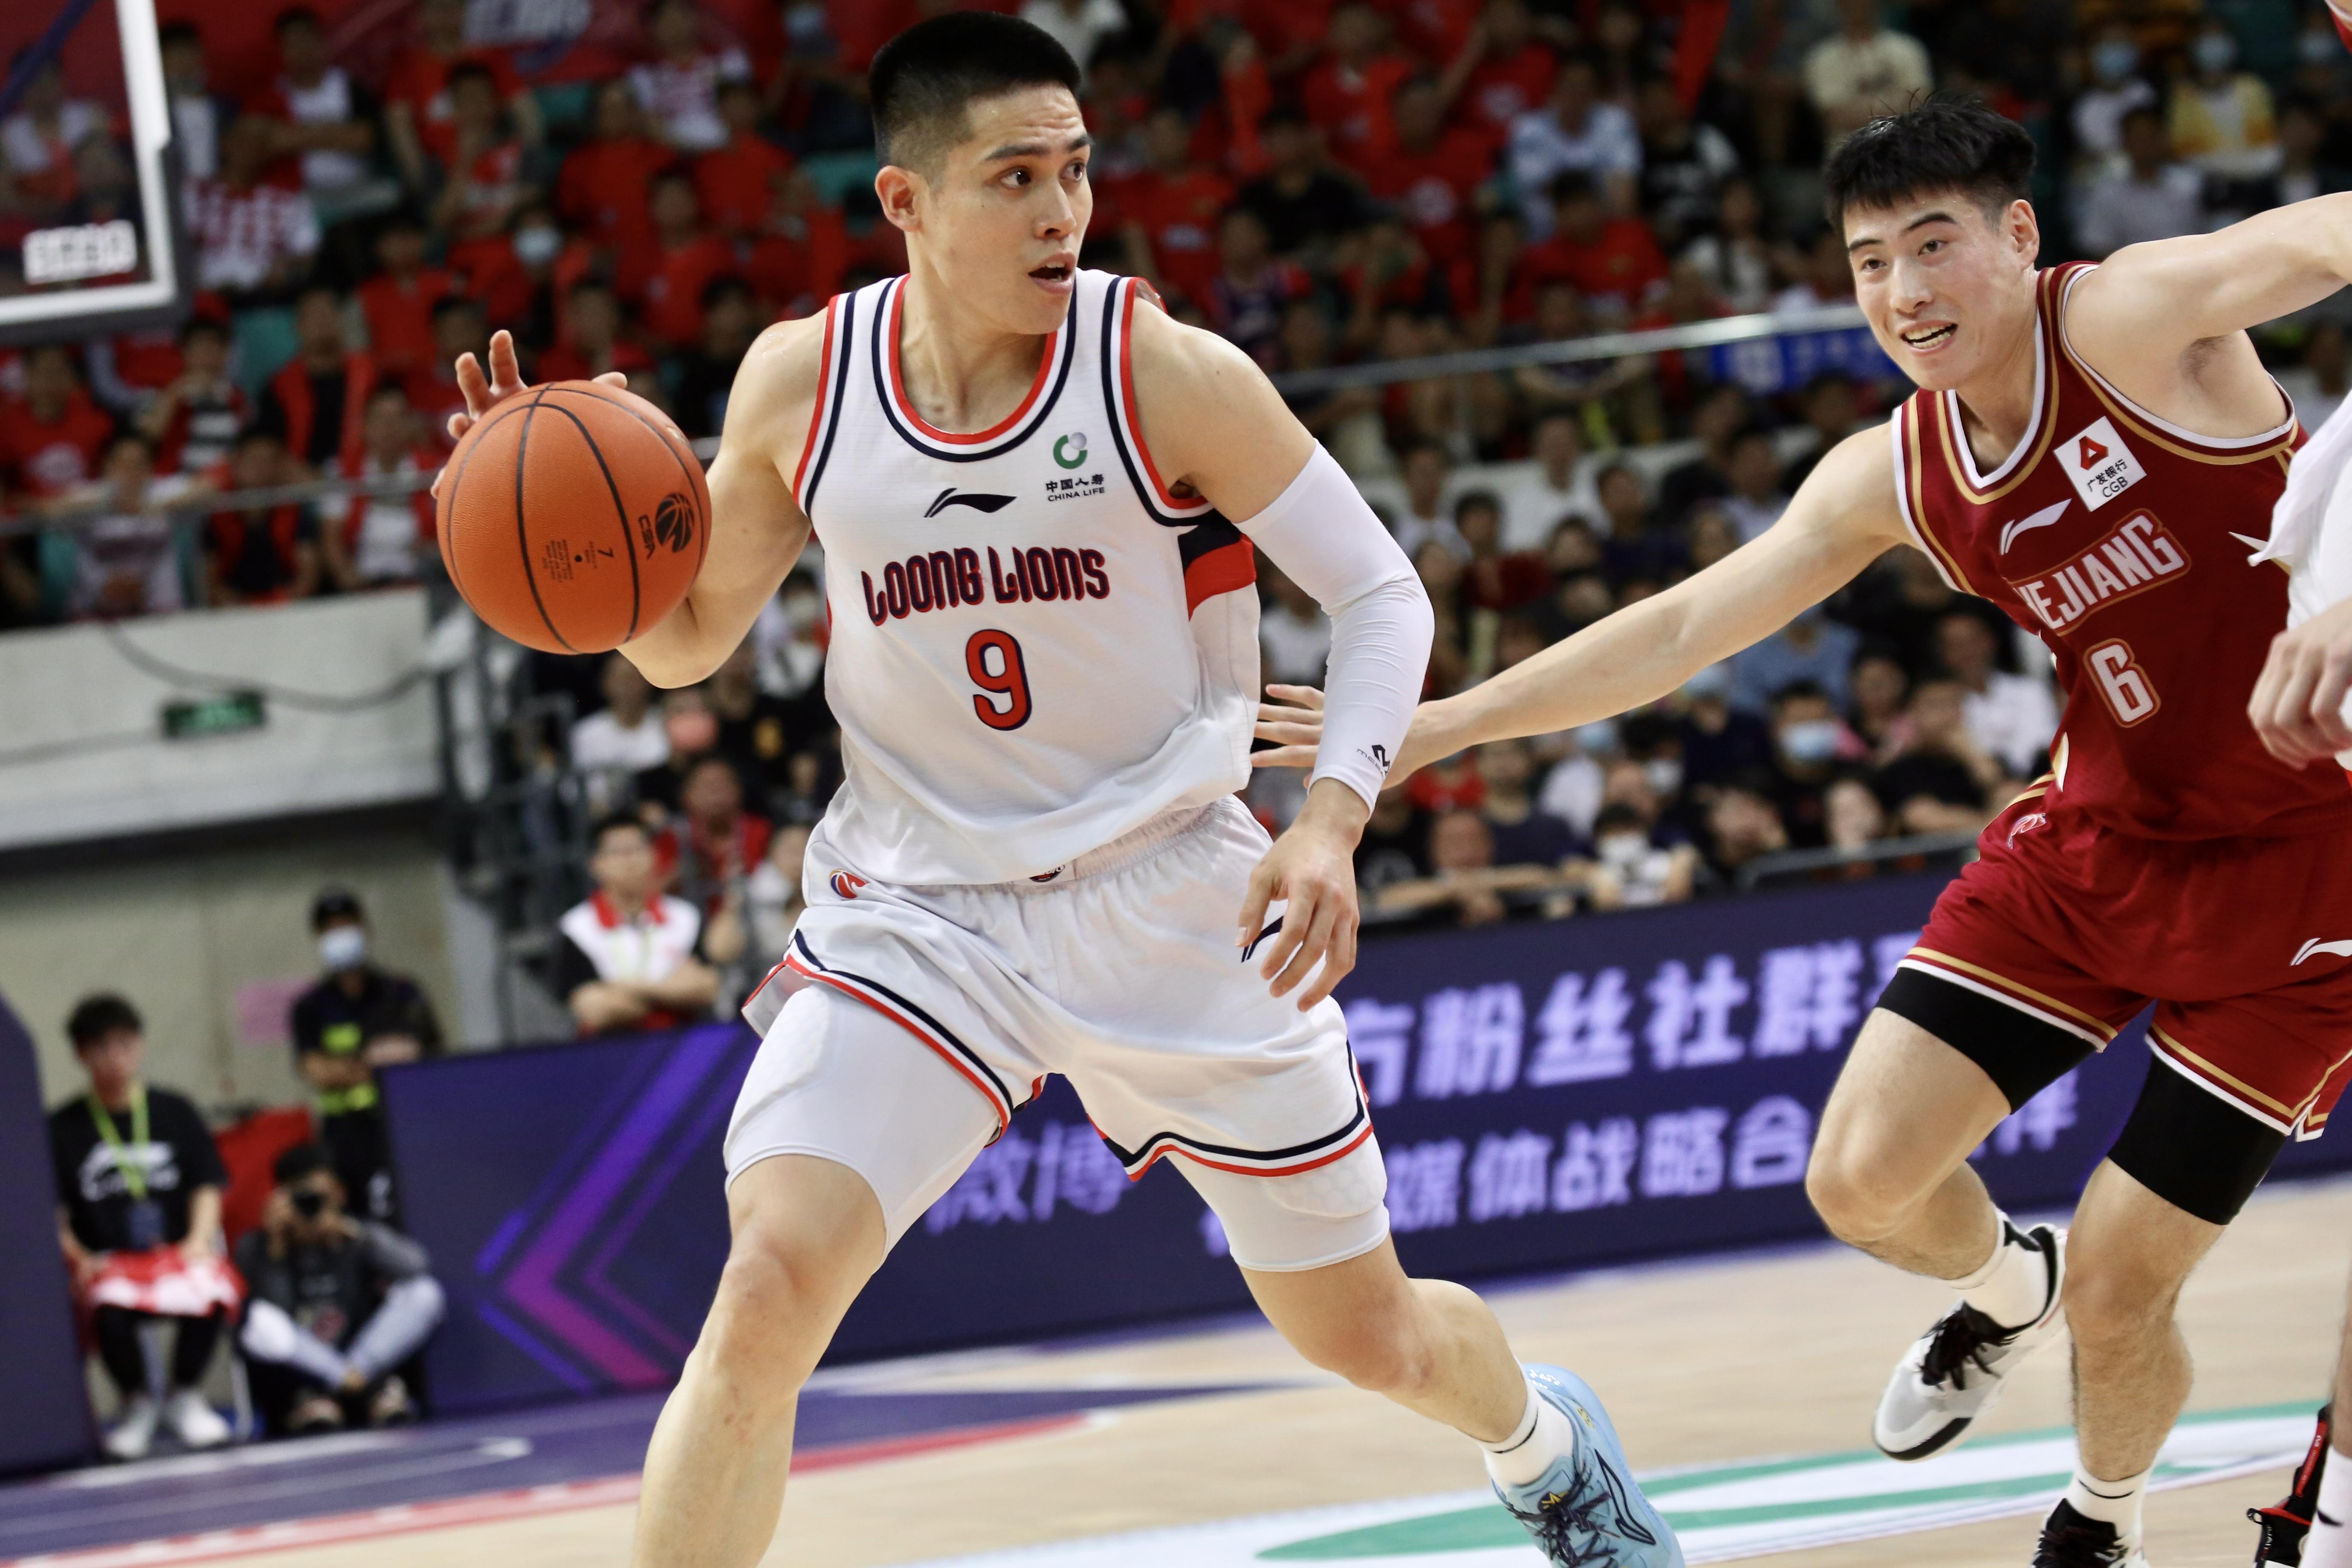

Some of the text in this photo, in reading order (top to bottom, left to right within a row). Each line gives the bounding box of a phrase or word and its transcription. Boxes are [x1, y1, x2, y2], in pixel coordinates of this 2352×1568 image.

[1045, 474, 1104, 493] 中国人寿
[2087, 459, 2128, 492] 广发银行
[2102, 476, 2128, 498] CGB
[1048, 487, 1105, 502] CHINA LIFE
[861, 546, 1110, 627] LOONG LIONS
[965, 629, 1032, 731] 9
[2089, 641, 2156, 725] 6
